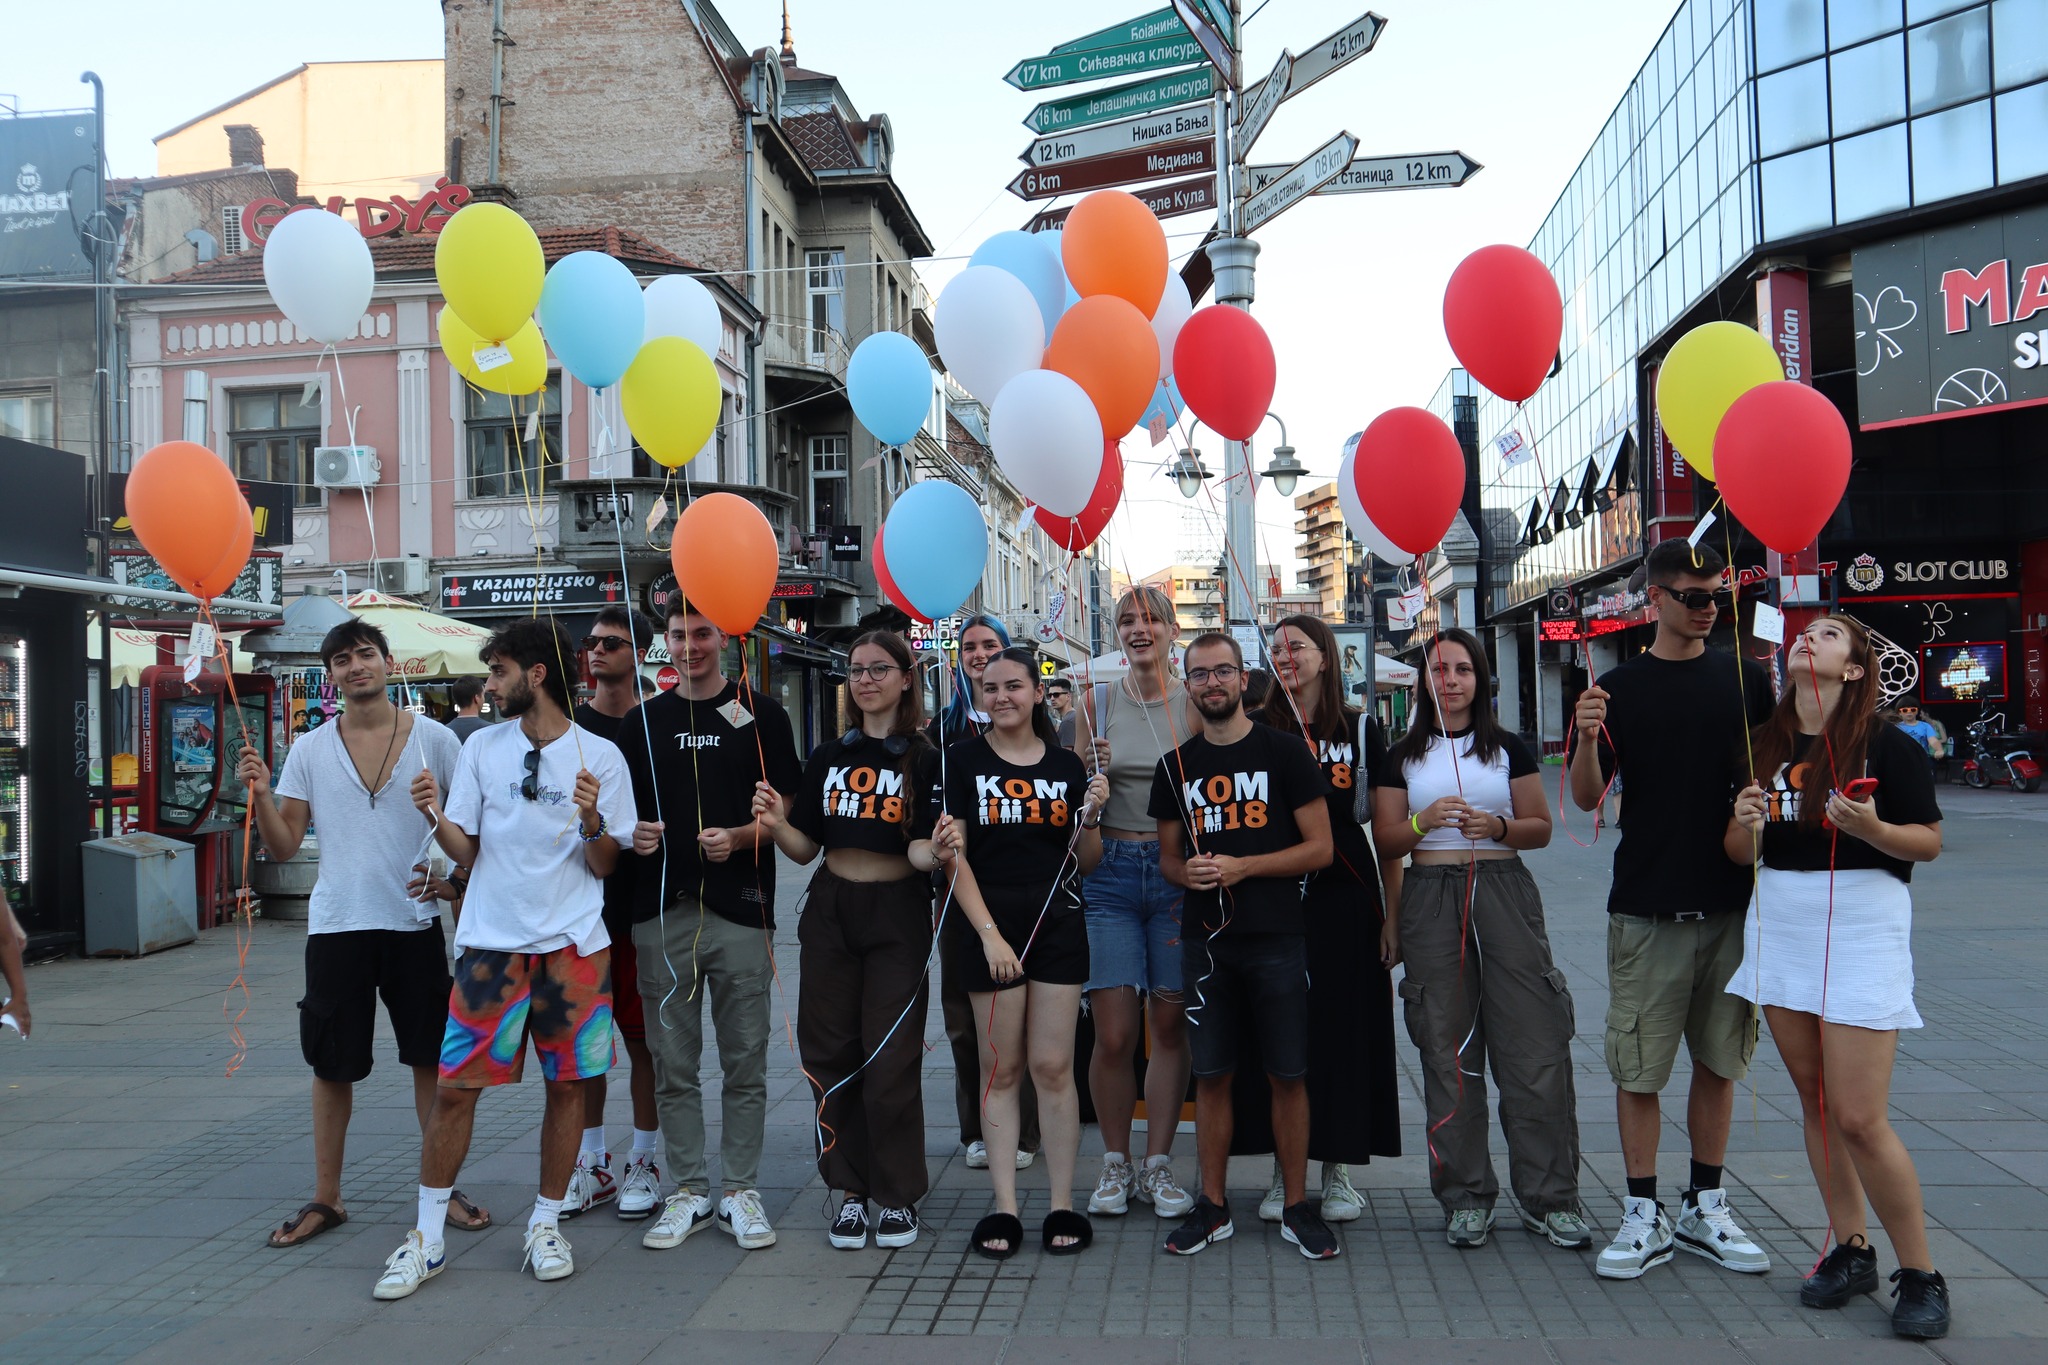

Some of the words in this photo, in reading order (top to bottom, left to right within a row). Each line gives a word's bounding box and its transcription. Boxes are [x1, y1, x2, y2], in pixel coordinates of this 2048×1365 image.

[1331, 37, 1348, 61] 4.5
[1348, 30, 1365, 52] km
[1023, 66, 1037, 83] 17
[1040, 64, 1061, 81] km
[1079, 50, 1146, 73] Сићевачка
[1149, 41, 1202, 61] клисура
[1038, 109, 1049, 127] 16
[1052, 107, 1072, 124] km
[1087, 91, 1157, 116] Јелашничка
[1159, 77, 1209, 100] клисура
[1039, 145, 1052, 162] 12
[1055, 142, 1075, 159] km
[1132, 123, 1172, 142] Нишка
[1175, 114, 1209, 133] Бања
[1026, 176, 1036, 192] 6
[1039, 174, 1061, 190] km
[1147, 150, 1203, 172] Медиана
[1314, 158, 1328, 179] 0.8
[1328, 149, 1343, 171] km
[1340, 167, 1394, 186] станица
[1405, 162, 1425, 182] 1.2
[1427, 161, 1452, 180] km
[1174, 188, 1205, 209] Кула
[1779, 308, 1800, 383] eridian
[472, 575, 596, 591] KAZANDŽIJSKO
[1895, 561, 1947, 582] SLOT
[1950, 559, 2009, 580] CLUB
[491, 588, 564, 603] DUVANČE
[912, 640, 960, 650] OBUCA
[674, 732, 721, 750] Tupac
[823, 766, 904, 797] KOM
[975, 774, 1068, 803] KOM
[1182, 771, 1269, 810] KOM
[859, 794, 903, 823] 18
[1025, 799, 1068, 827] 18
[1224, 800, 1269, 830] 18
